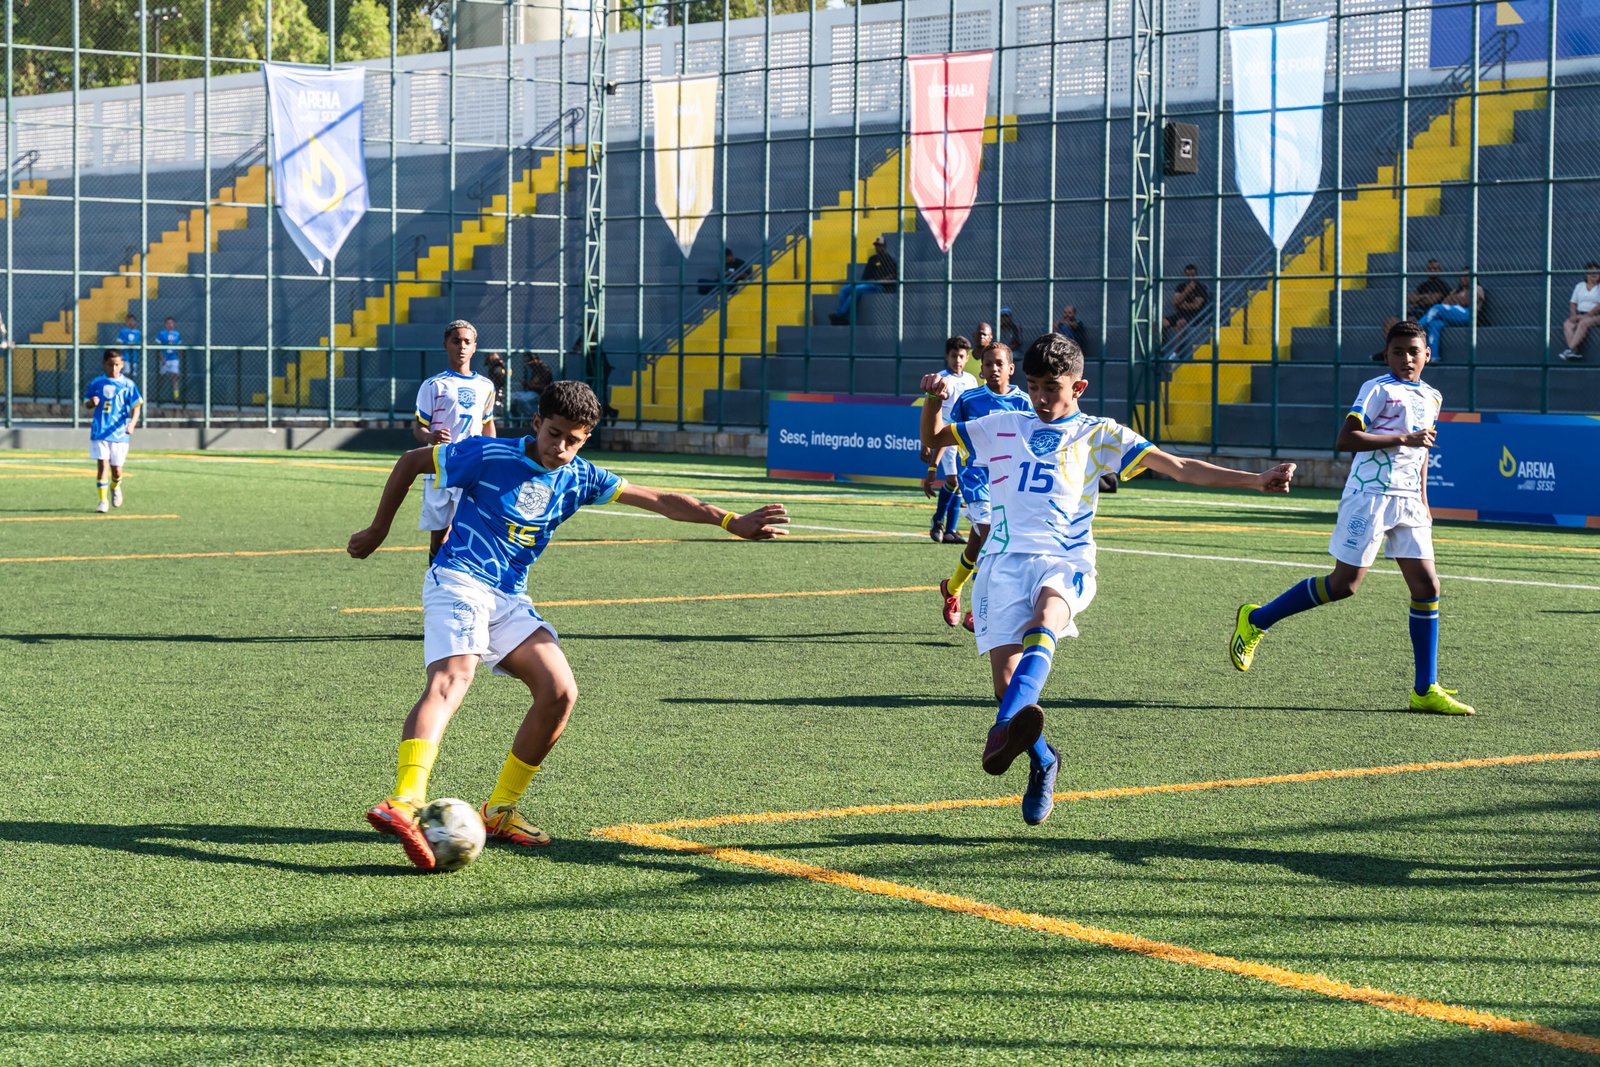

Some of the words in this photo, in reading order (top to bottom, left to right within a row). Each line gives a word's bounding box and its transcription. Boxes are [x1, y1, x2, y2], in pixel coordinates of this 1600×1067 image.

[298, 90, 341, 109] ARENA
[103, 400, 112, 413] 5
[459, 414, 472, 433] 7
[779, 428, 808, 448] Sesc,
[811, 430, 864, 450] integrado
[867, 436, 882, 449] ao
[1018, 461, 1055, 494] 15
[1517, 461, 1556, 479] ARENA
[1536, 480, 1556, 491] SESC
[505, 522, 540, 546] 15
